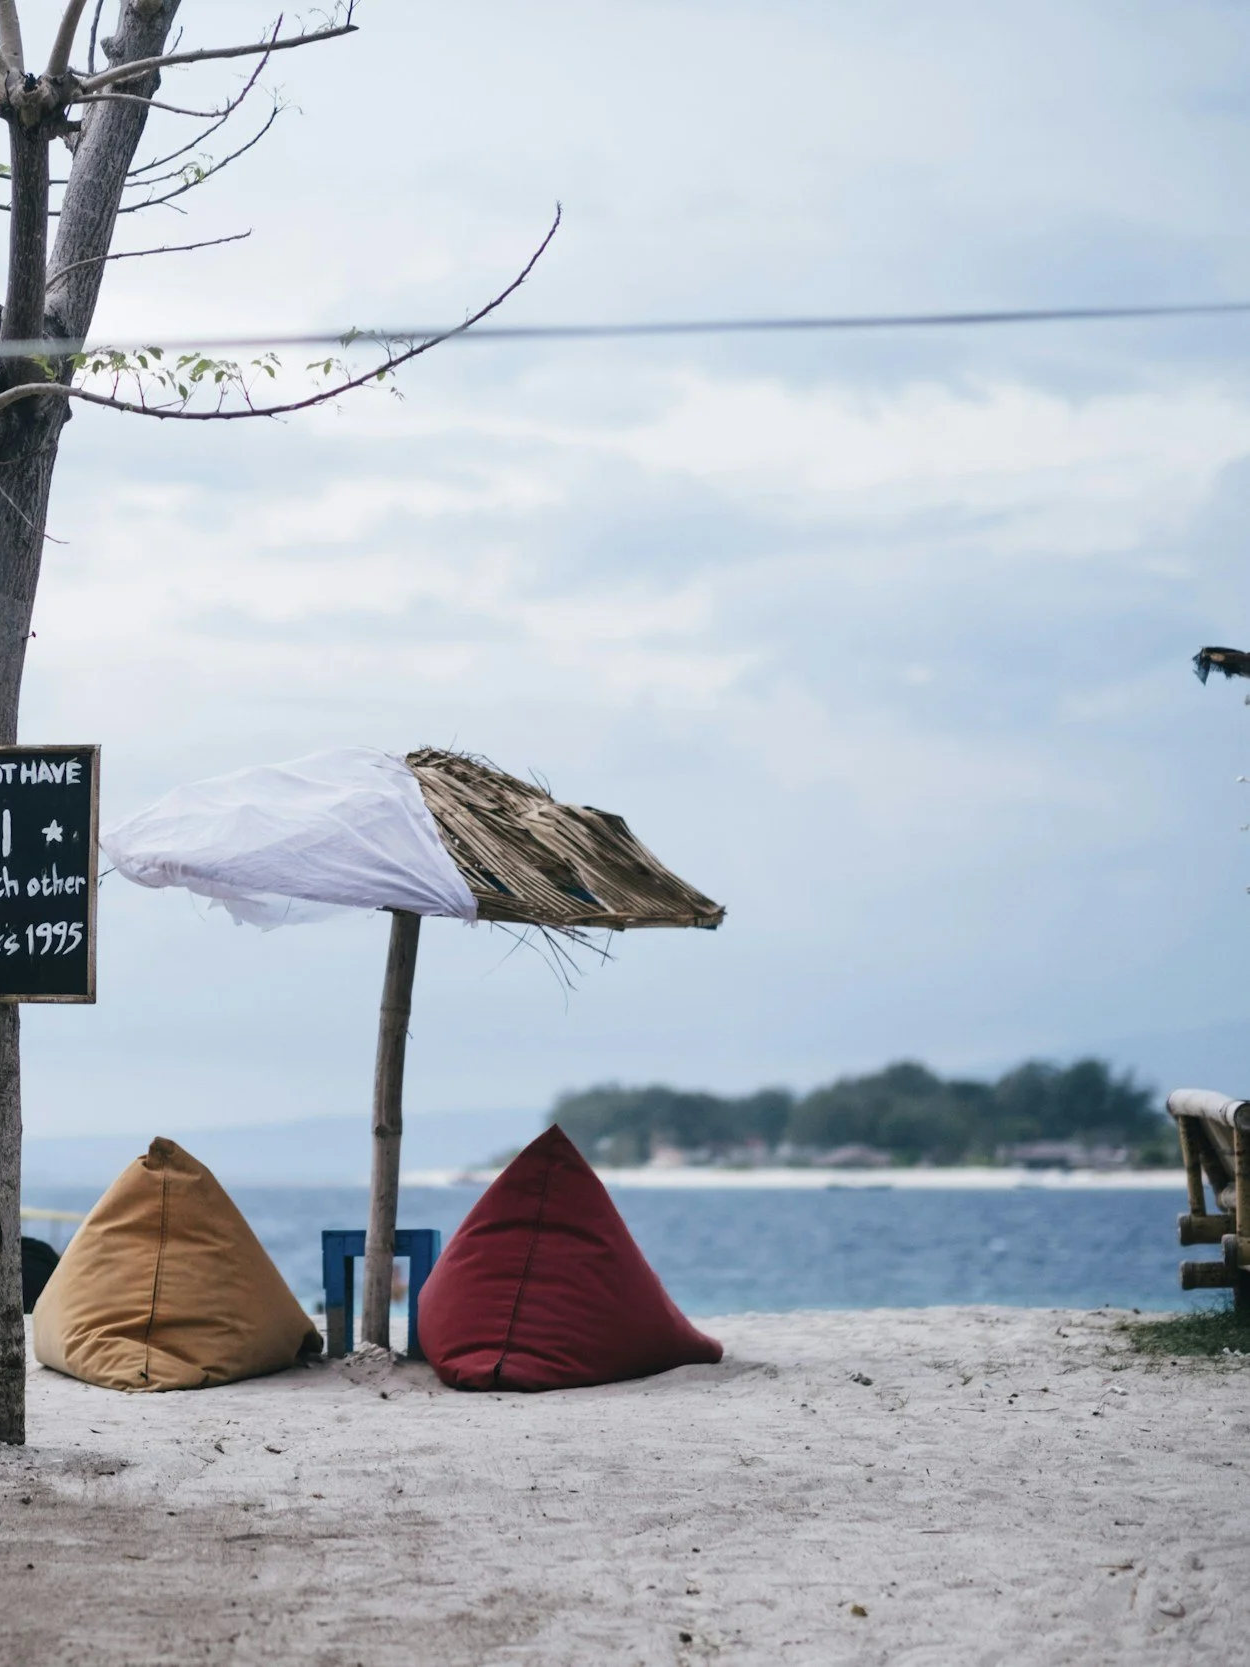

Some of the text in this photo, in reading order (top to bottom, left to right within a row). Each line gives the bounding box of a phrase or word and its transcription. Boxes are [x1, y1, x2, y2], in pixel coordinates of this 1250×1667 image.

[20, 757, 82, 785] HAVE
[26, 862, 86, 898] other
[25, 920, 84, 956] 1995
